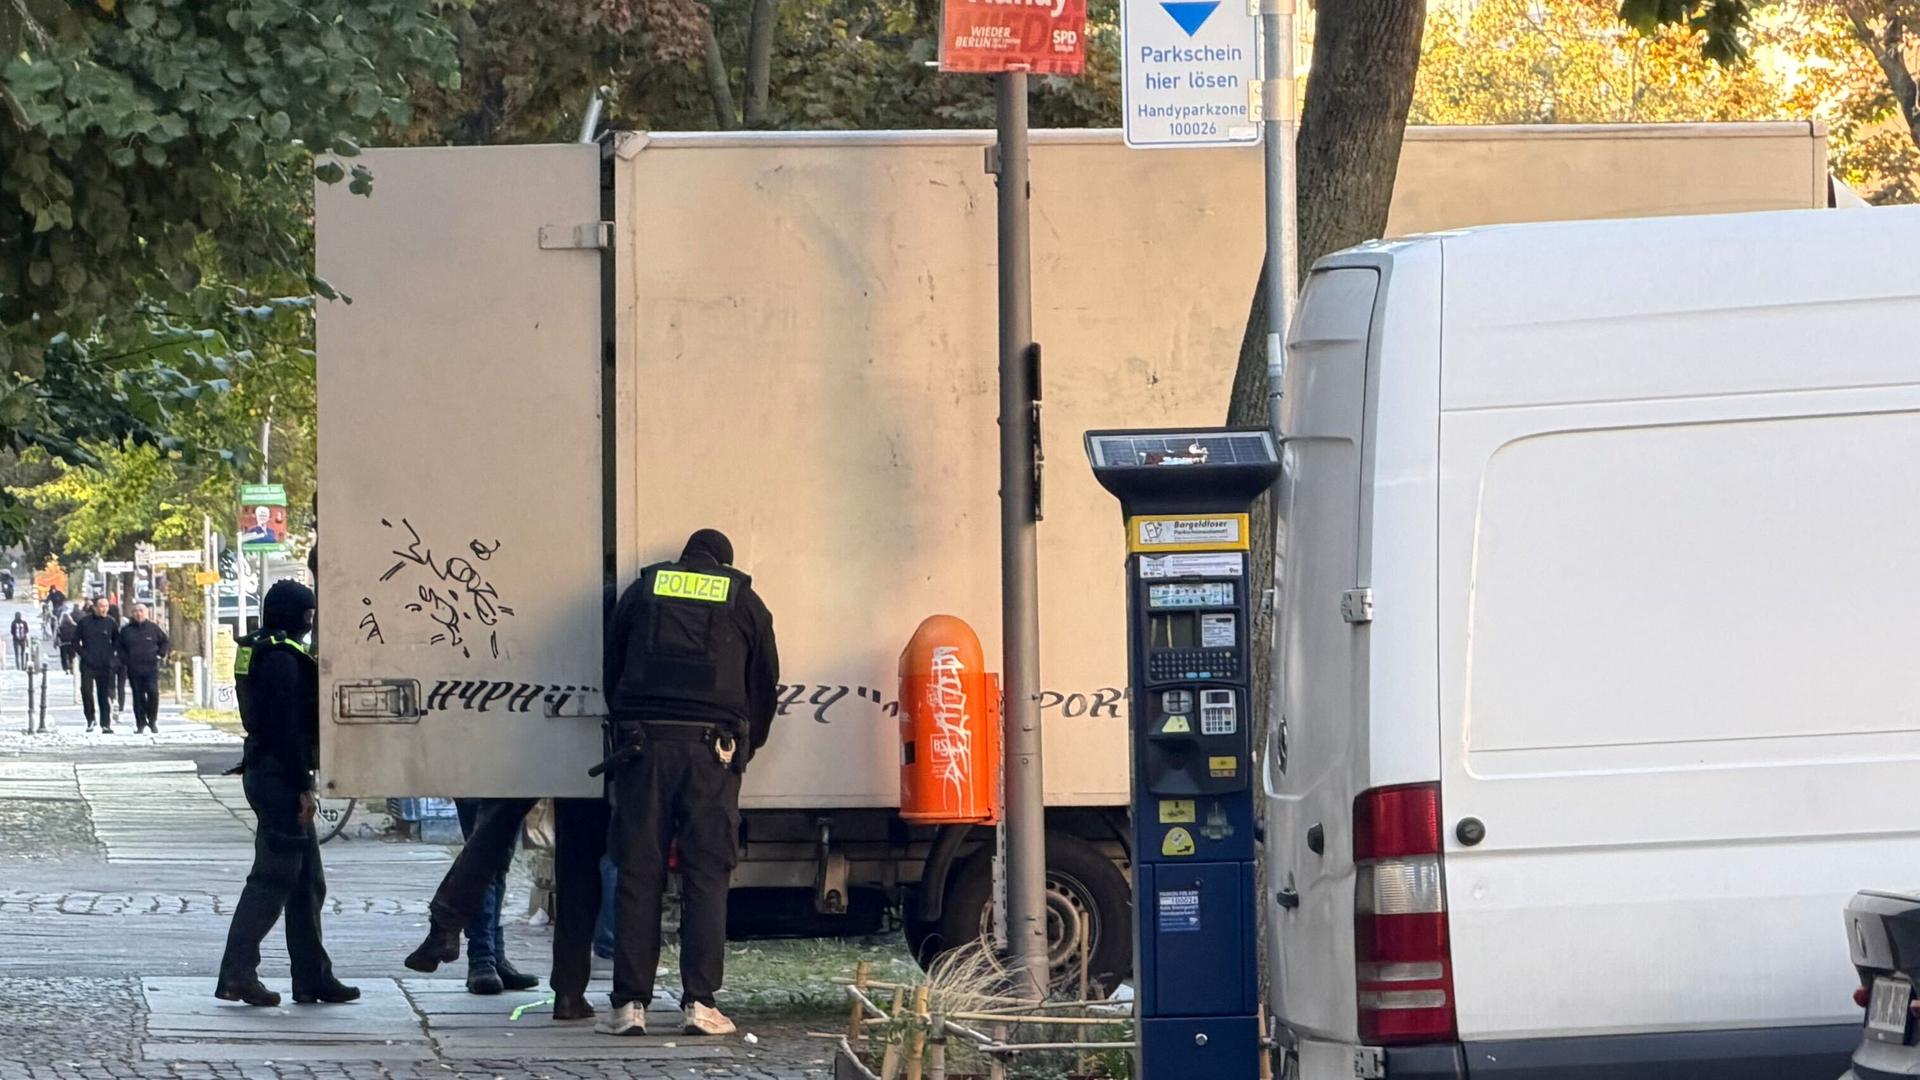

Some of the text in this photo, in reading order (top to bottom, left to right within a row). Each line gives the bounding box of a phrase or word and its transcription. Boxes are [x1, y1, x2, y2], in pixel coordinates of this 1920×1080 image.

[970, 25, 1011, 38] WIEDER
[1053, 30, 1077, 44] SPD
[955, 36, 991, 48] BERLIN
[1141, 44, 1242, 62] Parkschein
[1146, 71, 1238, 89] hier lösen
[1138, 103, 1247, 119] Handyparkzone
[1170, 122, 1217, 136] 100026
[1174, 519, 1227, 530] Bargeldloser
[656, 573, 727, 599] POLIZEI
